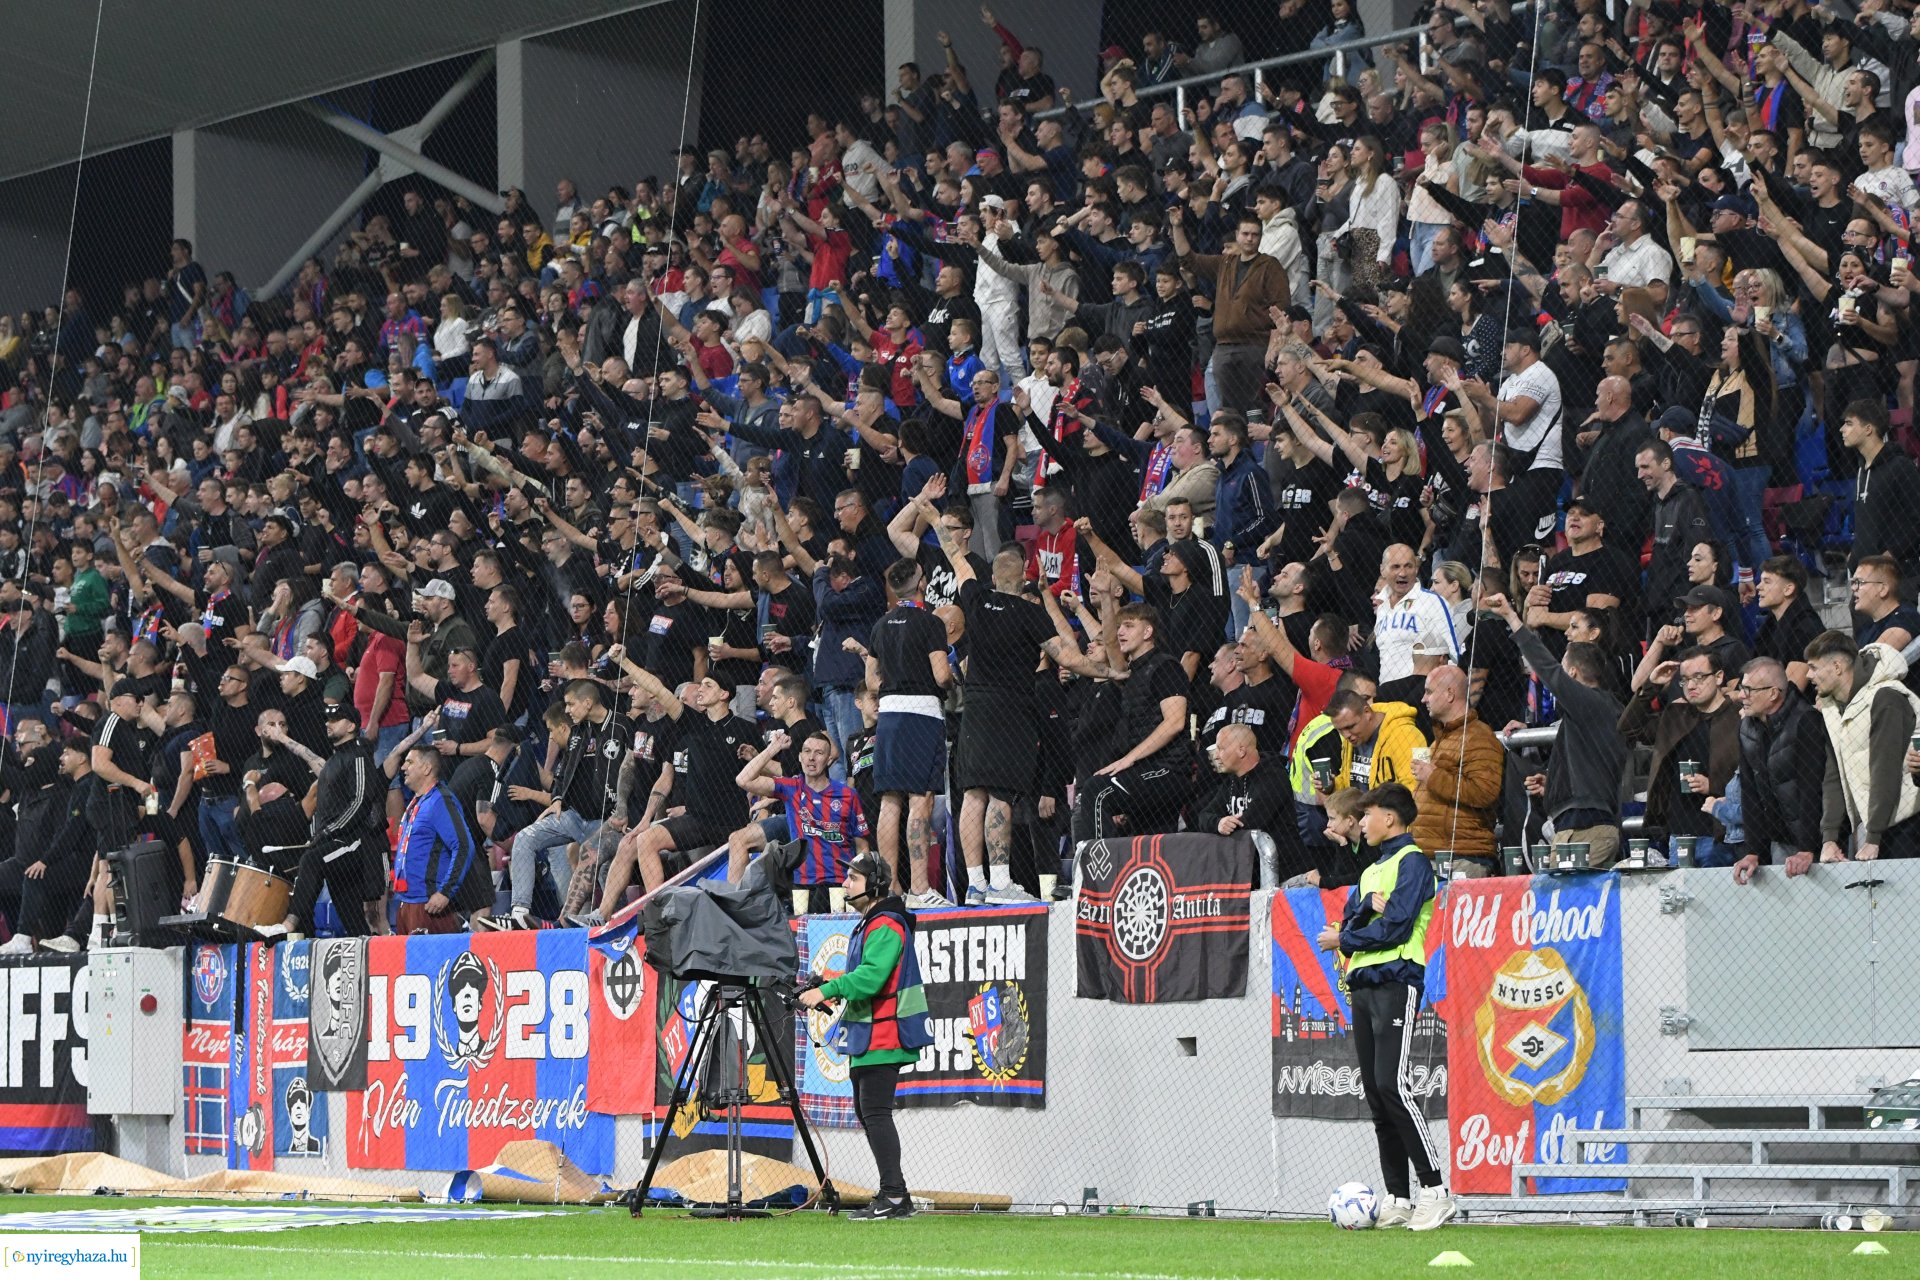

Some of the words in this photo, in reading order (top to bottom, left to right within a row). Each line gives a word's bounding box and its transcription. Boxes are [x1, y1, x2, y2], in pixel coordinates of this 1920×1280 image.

[1376, 612, 1418, 634] ALIA
[1172, 892, 1222, 920] Antifa
[1452, 893, 1502, 948] Old
[1512, 878, 1614, 946] School
[914, 924, 1026, 984] ASTERN
[341, 940, 355, 1039] NYSFC
[1497, 980, 1565, 1005] NYVSSC
[366, 1072, 422, 1138] Vén
[434, 1075, 588, 1138] Tinédzserek
[1456, 1113, 1530, 1171] Best
[1541, 1110, 1617, 1165] Stle
